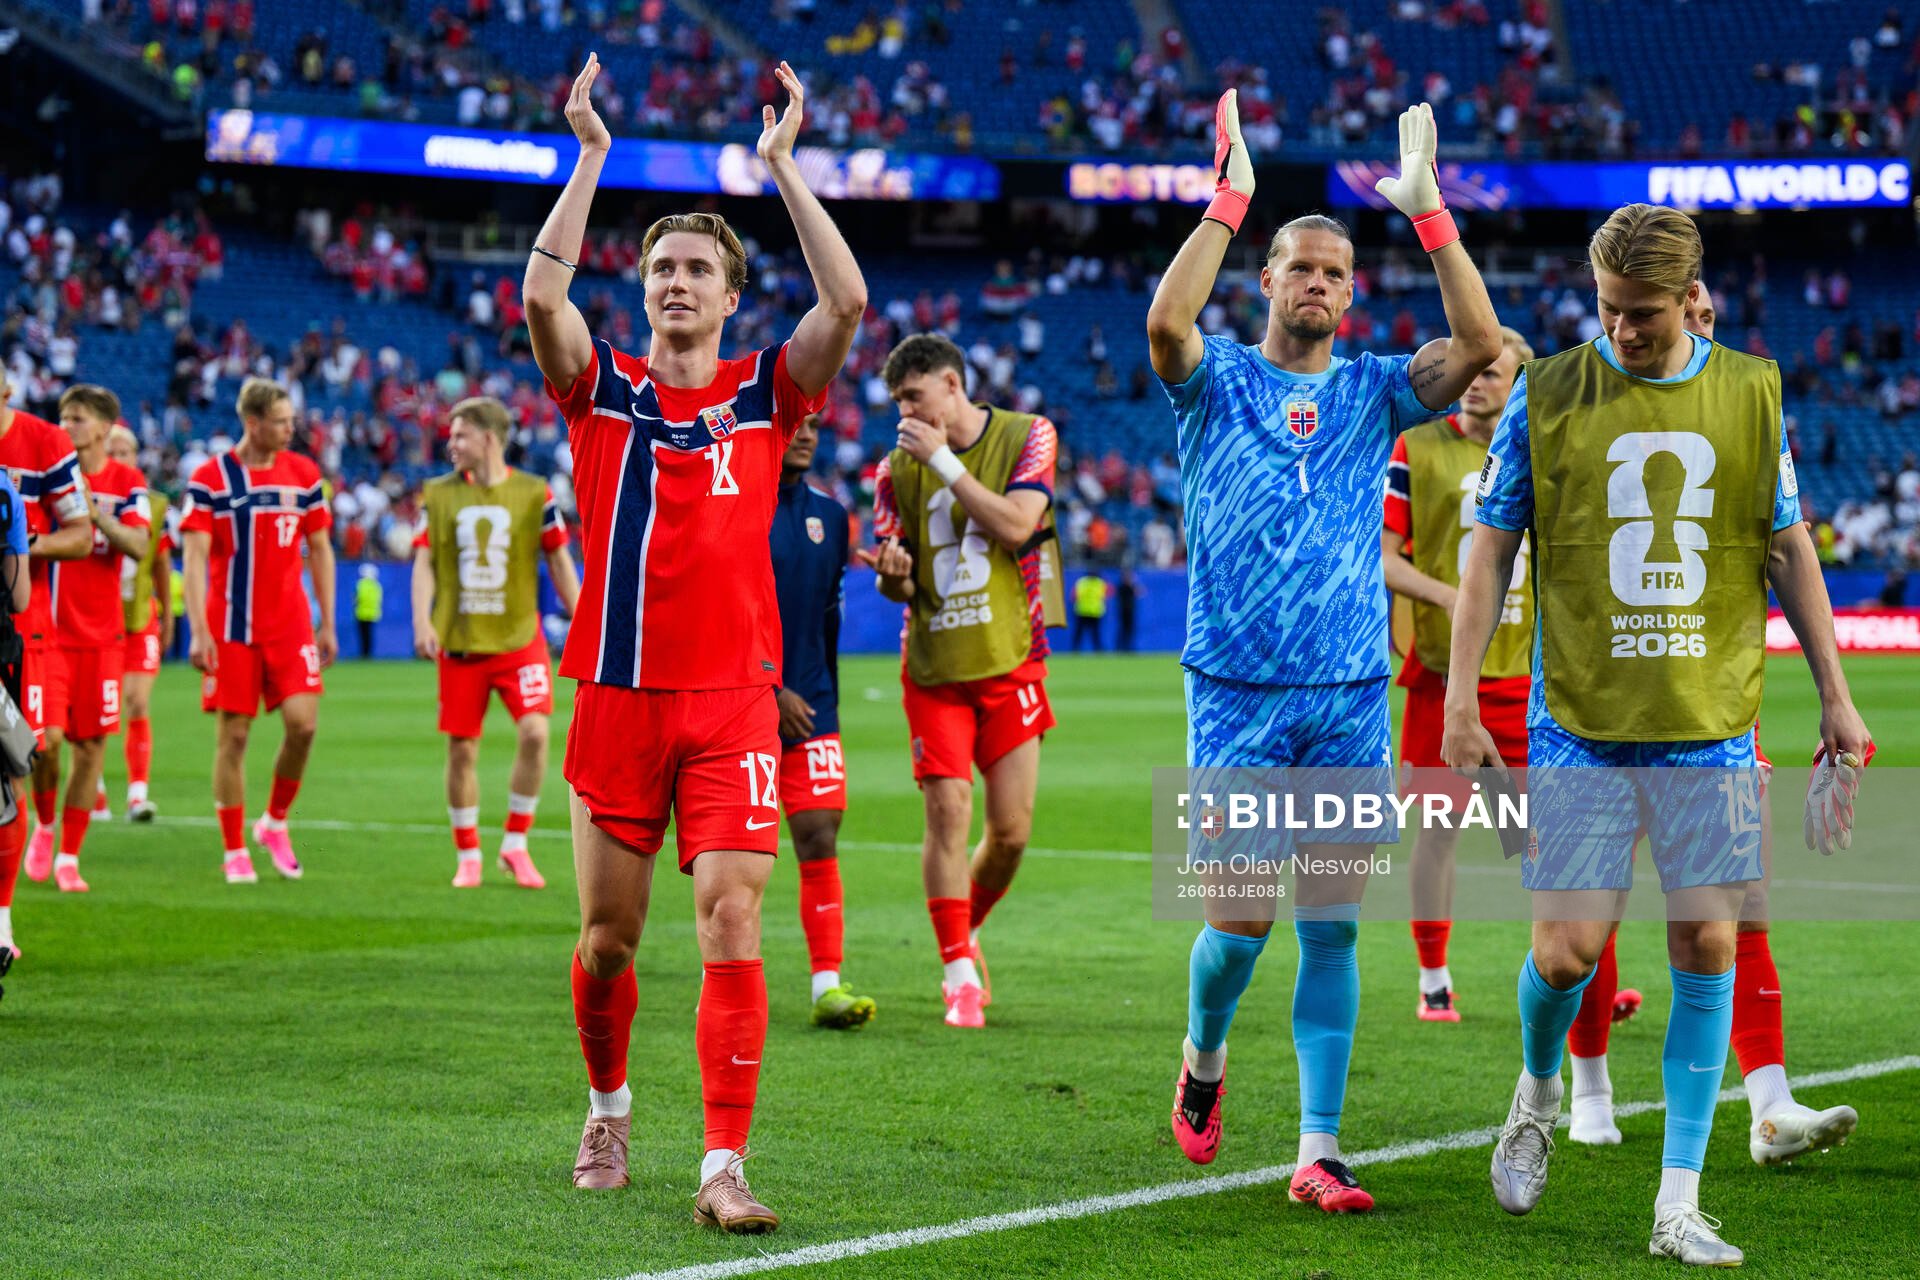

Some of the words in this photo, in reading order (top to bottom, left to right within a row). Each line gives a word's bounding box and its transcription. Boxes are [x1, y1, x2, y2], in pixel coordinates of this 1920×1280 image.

[1648, 166, 1735, 203] FIFA
[1734, 164, 1878, 202] WORLD
[1879, 163, 1909, 201] C
[704, 440, 739, 496] 18
[1294, 453, 1310, 493] 1
[275, 514, 299, 547] 17
[1641, 572, 1685, 589] FIFA
[1611, 614, 1677, 630] WORLD
[1679, 614, 1706, 630] CUP
[1610, 633, 1707, 658] 2026
[28, 685, 43, 723] 9
[1017, 684, 1038, 709] 11
[805, 740, 844, 780] 22
[740, 752, 777, 811] 18
